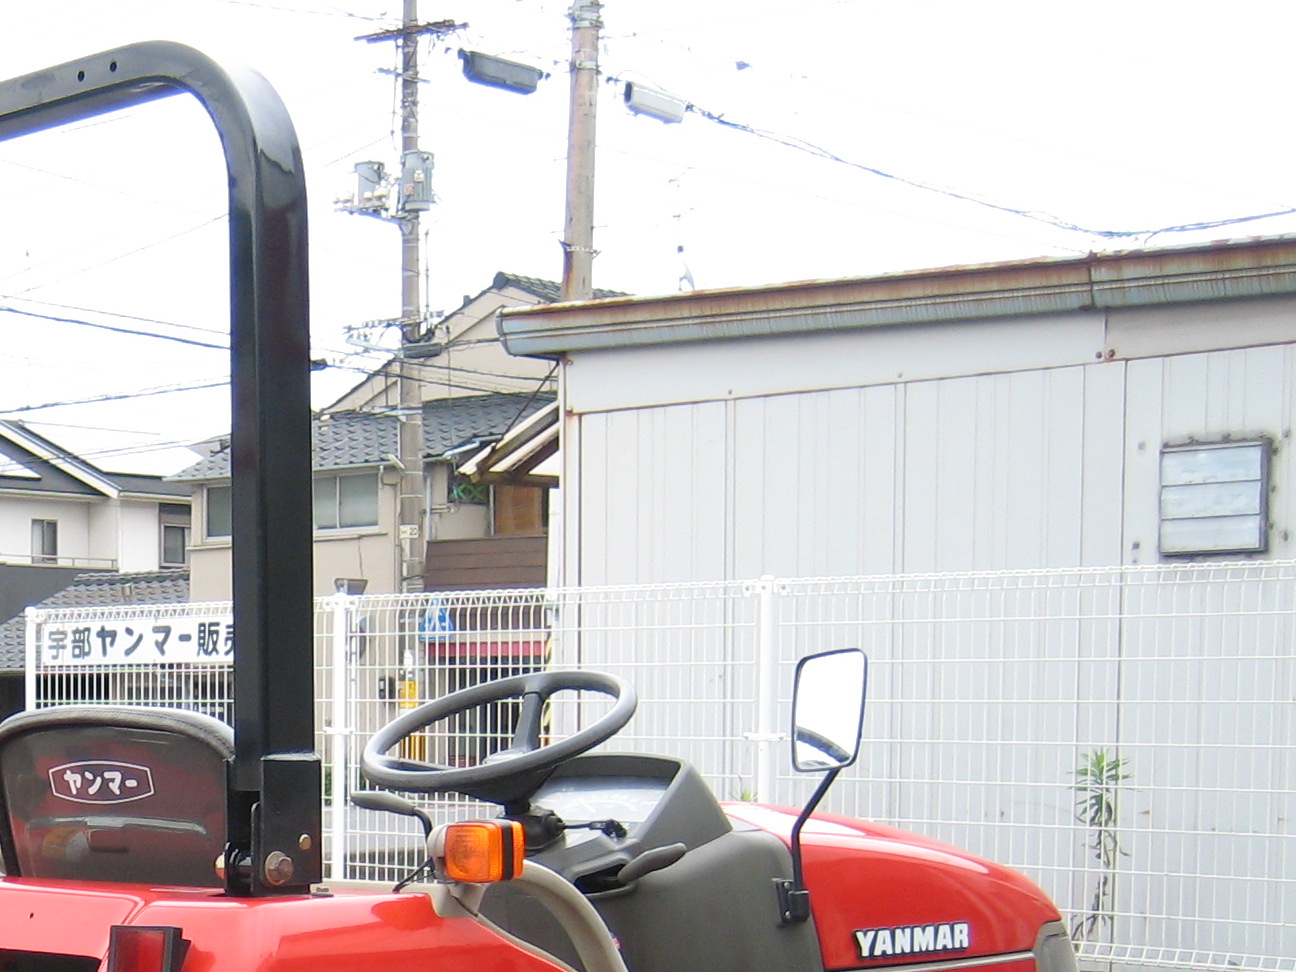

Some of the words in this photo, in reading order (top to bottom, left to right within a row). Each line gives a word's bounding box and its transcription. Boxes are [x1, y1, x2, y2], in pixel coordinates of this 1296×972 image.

[63, 769, 138, 795] ヤンマー
[855, 922, 970, 958] YANMAR
